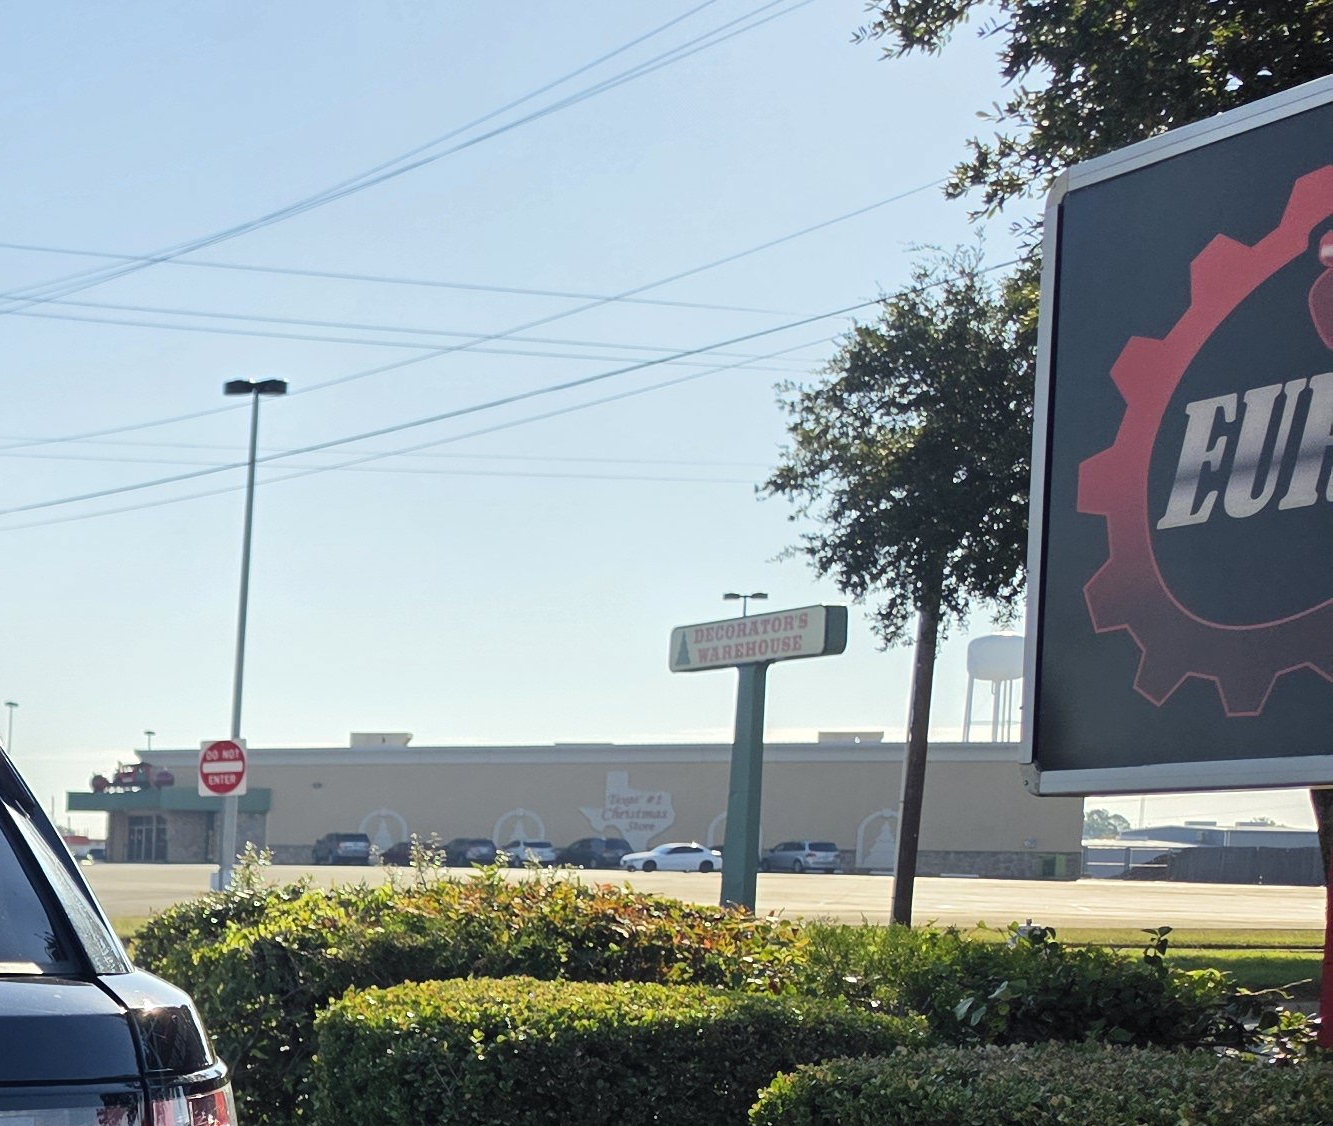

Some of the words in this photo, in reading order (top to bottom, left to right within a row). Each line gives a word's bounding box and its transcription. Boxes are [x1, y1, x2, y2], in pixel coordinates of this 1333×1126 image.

[694, 613, 808, 644] DECORATOR'S
[697, 635, 803, 663] WAREHOUSE
[206, 749, 219, 760] DO
[222, 748, 240, 760] NOT
[208, 774, 236, 785] ENTER
[601, 804, 668, 820] Christmas
